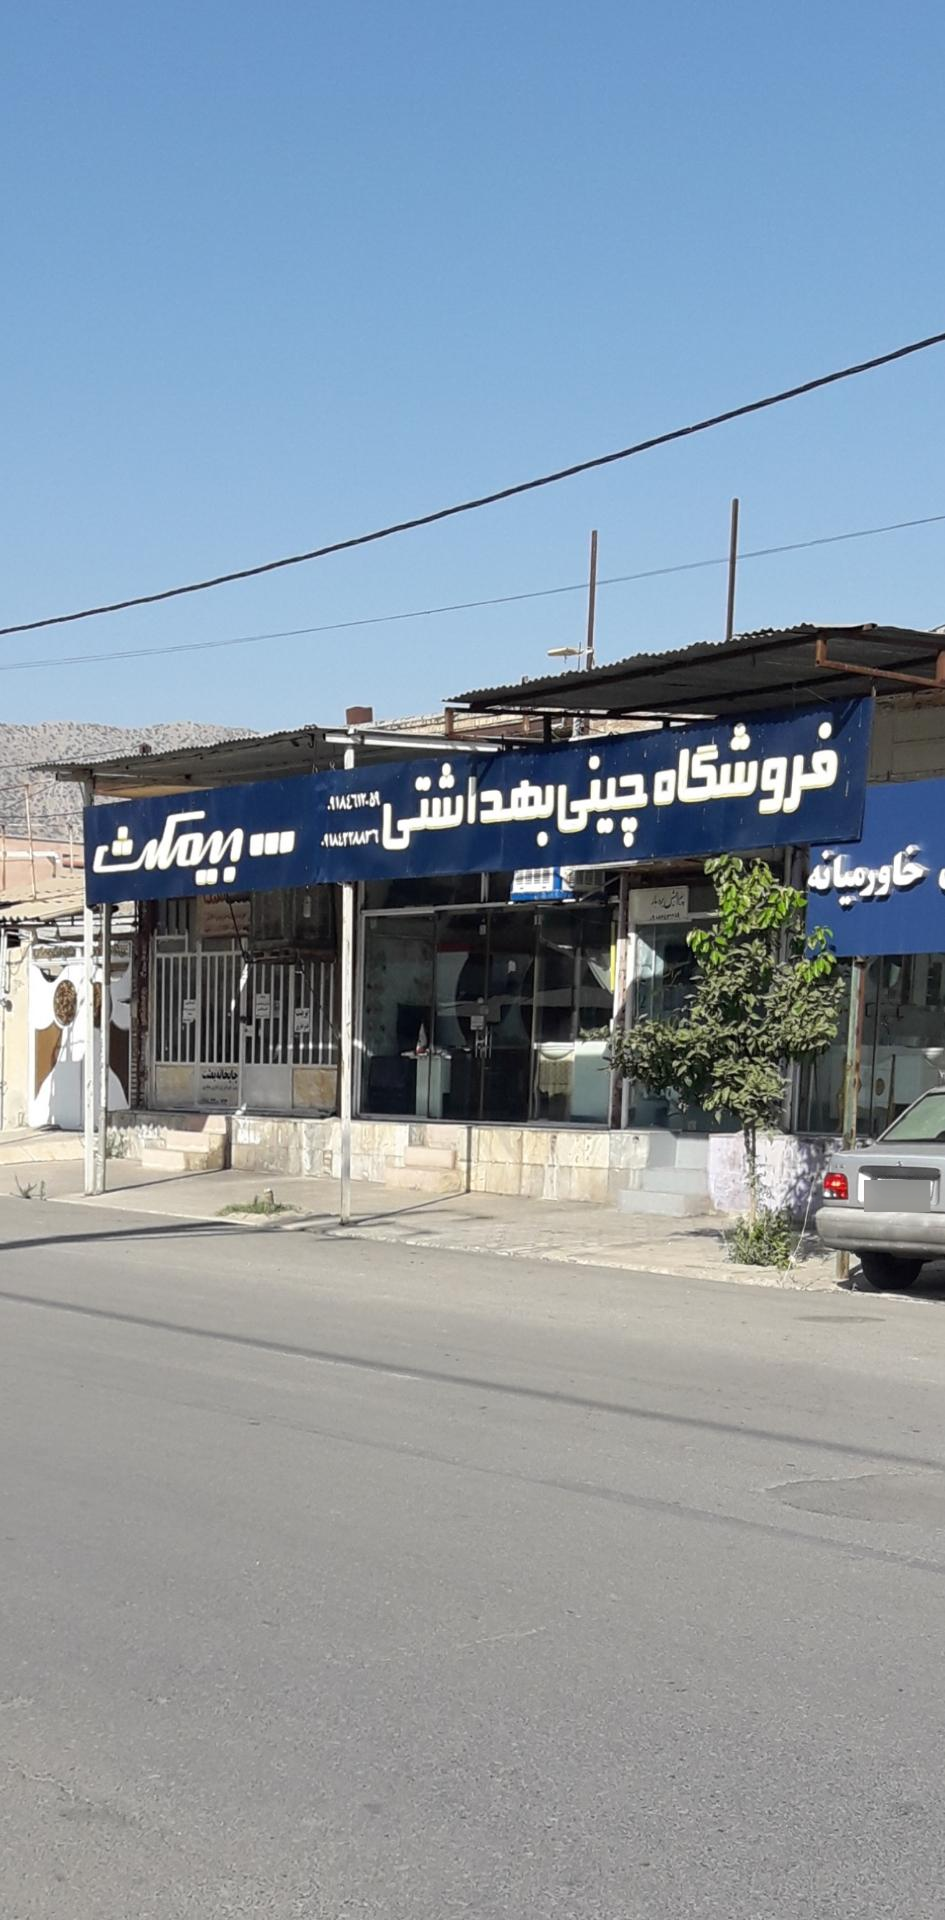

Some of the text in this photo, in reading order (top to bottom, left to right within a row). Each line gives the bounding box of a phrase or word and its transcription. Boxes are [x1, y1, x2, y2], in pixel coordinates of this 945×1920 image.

[381, 721, 839, 851] فروشگاه چینی بهداشتی
[807, 844, 932, 908] خاورمیانه
